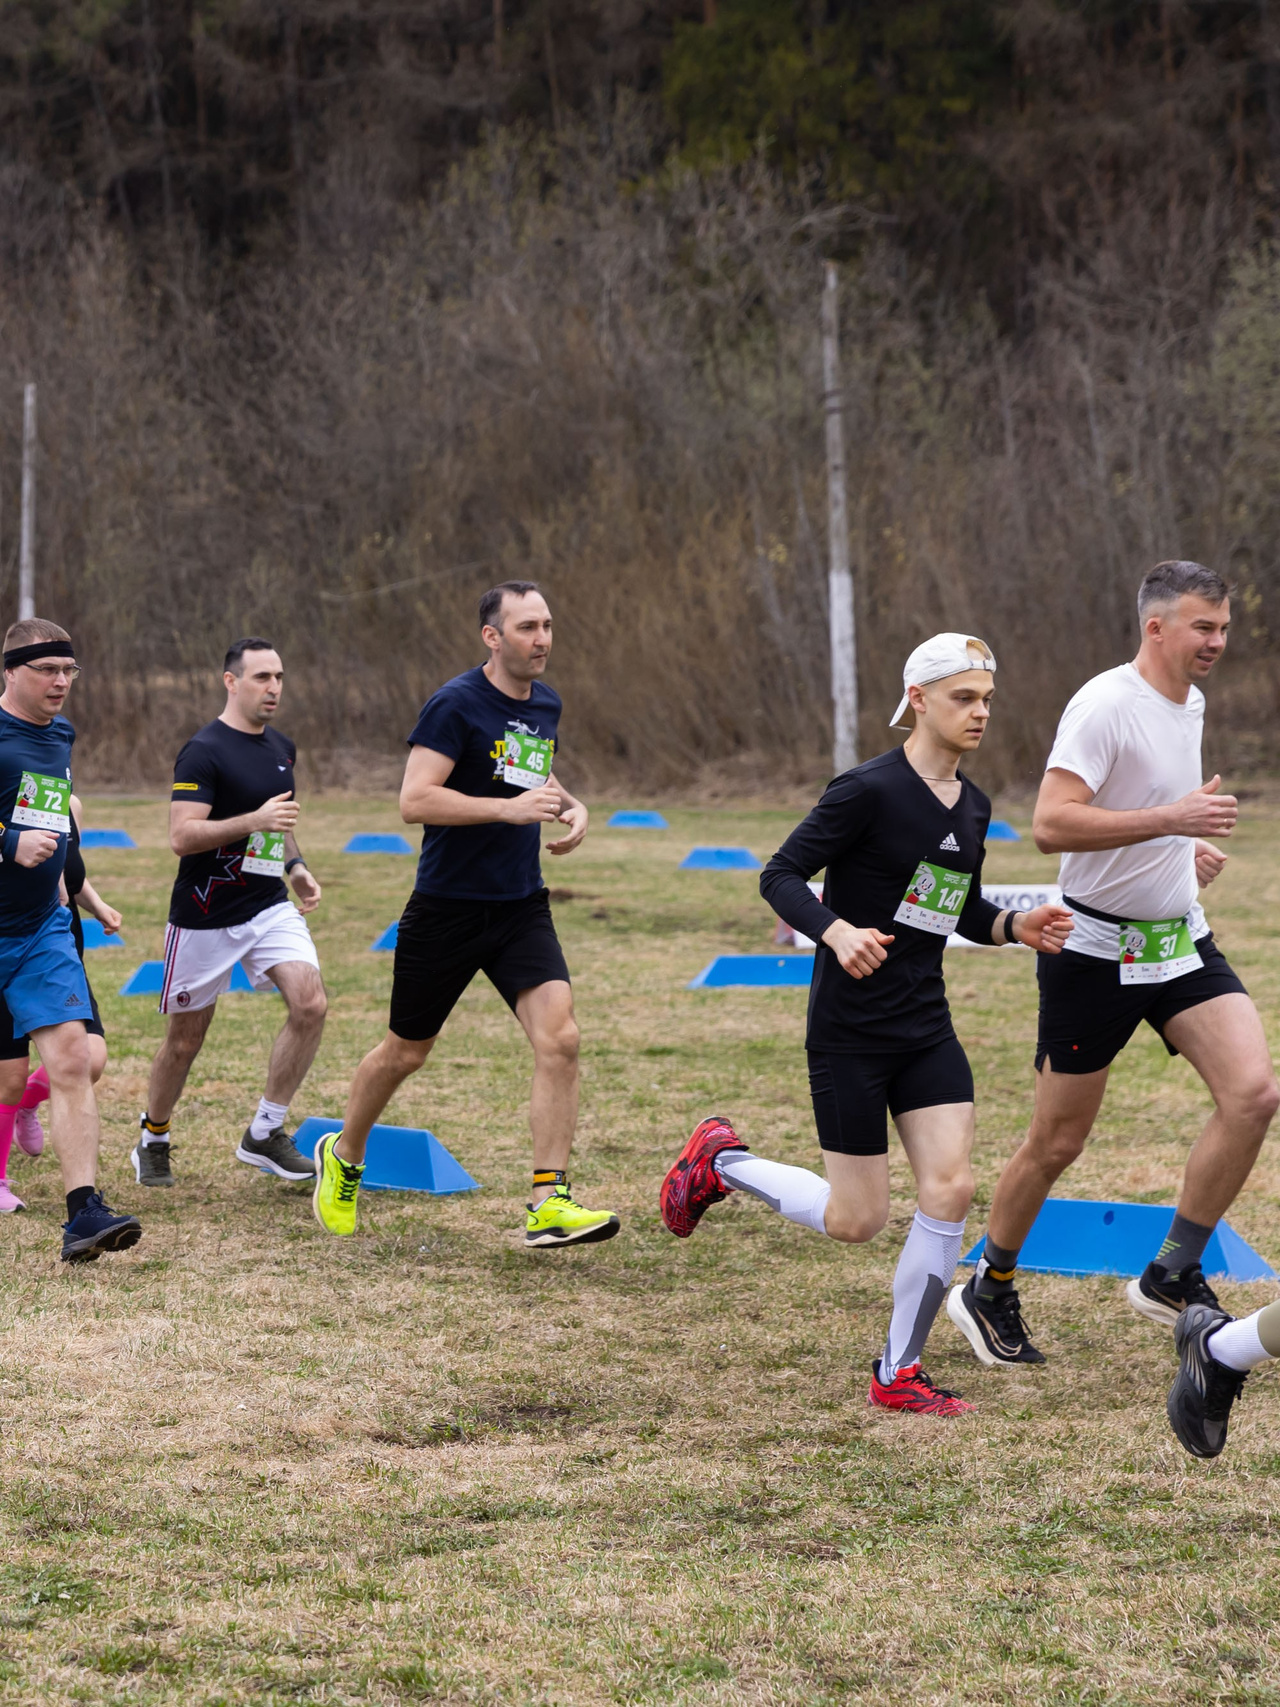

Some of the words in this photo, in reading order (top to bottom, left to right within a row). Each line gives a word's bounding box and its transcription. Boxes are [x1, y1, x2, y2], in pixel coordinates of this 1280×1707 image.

[526, 751, 545, 771] 45
[44, 789, 63, 811] 72
[269, 842, 284, 860] 46
[939, 843, 961, 852] adidas
[937, 887, 965, 911] 147
[1158, 933, 1178, 958] 37
